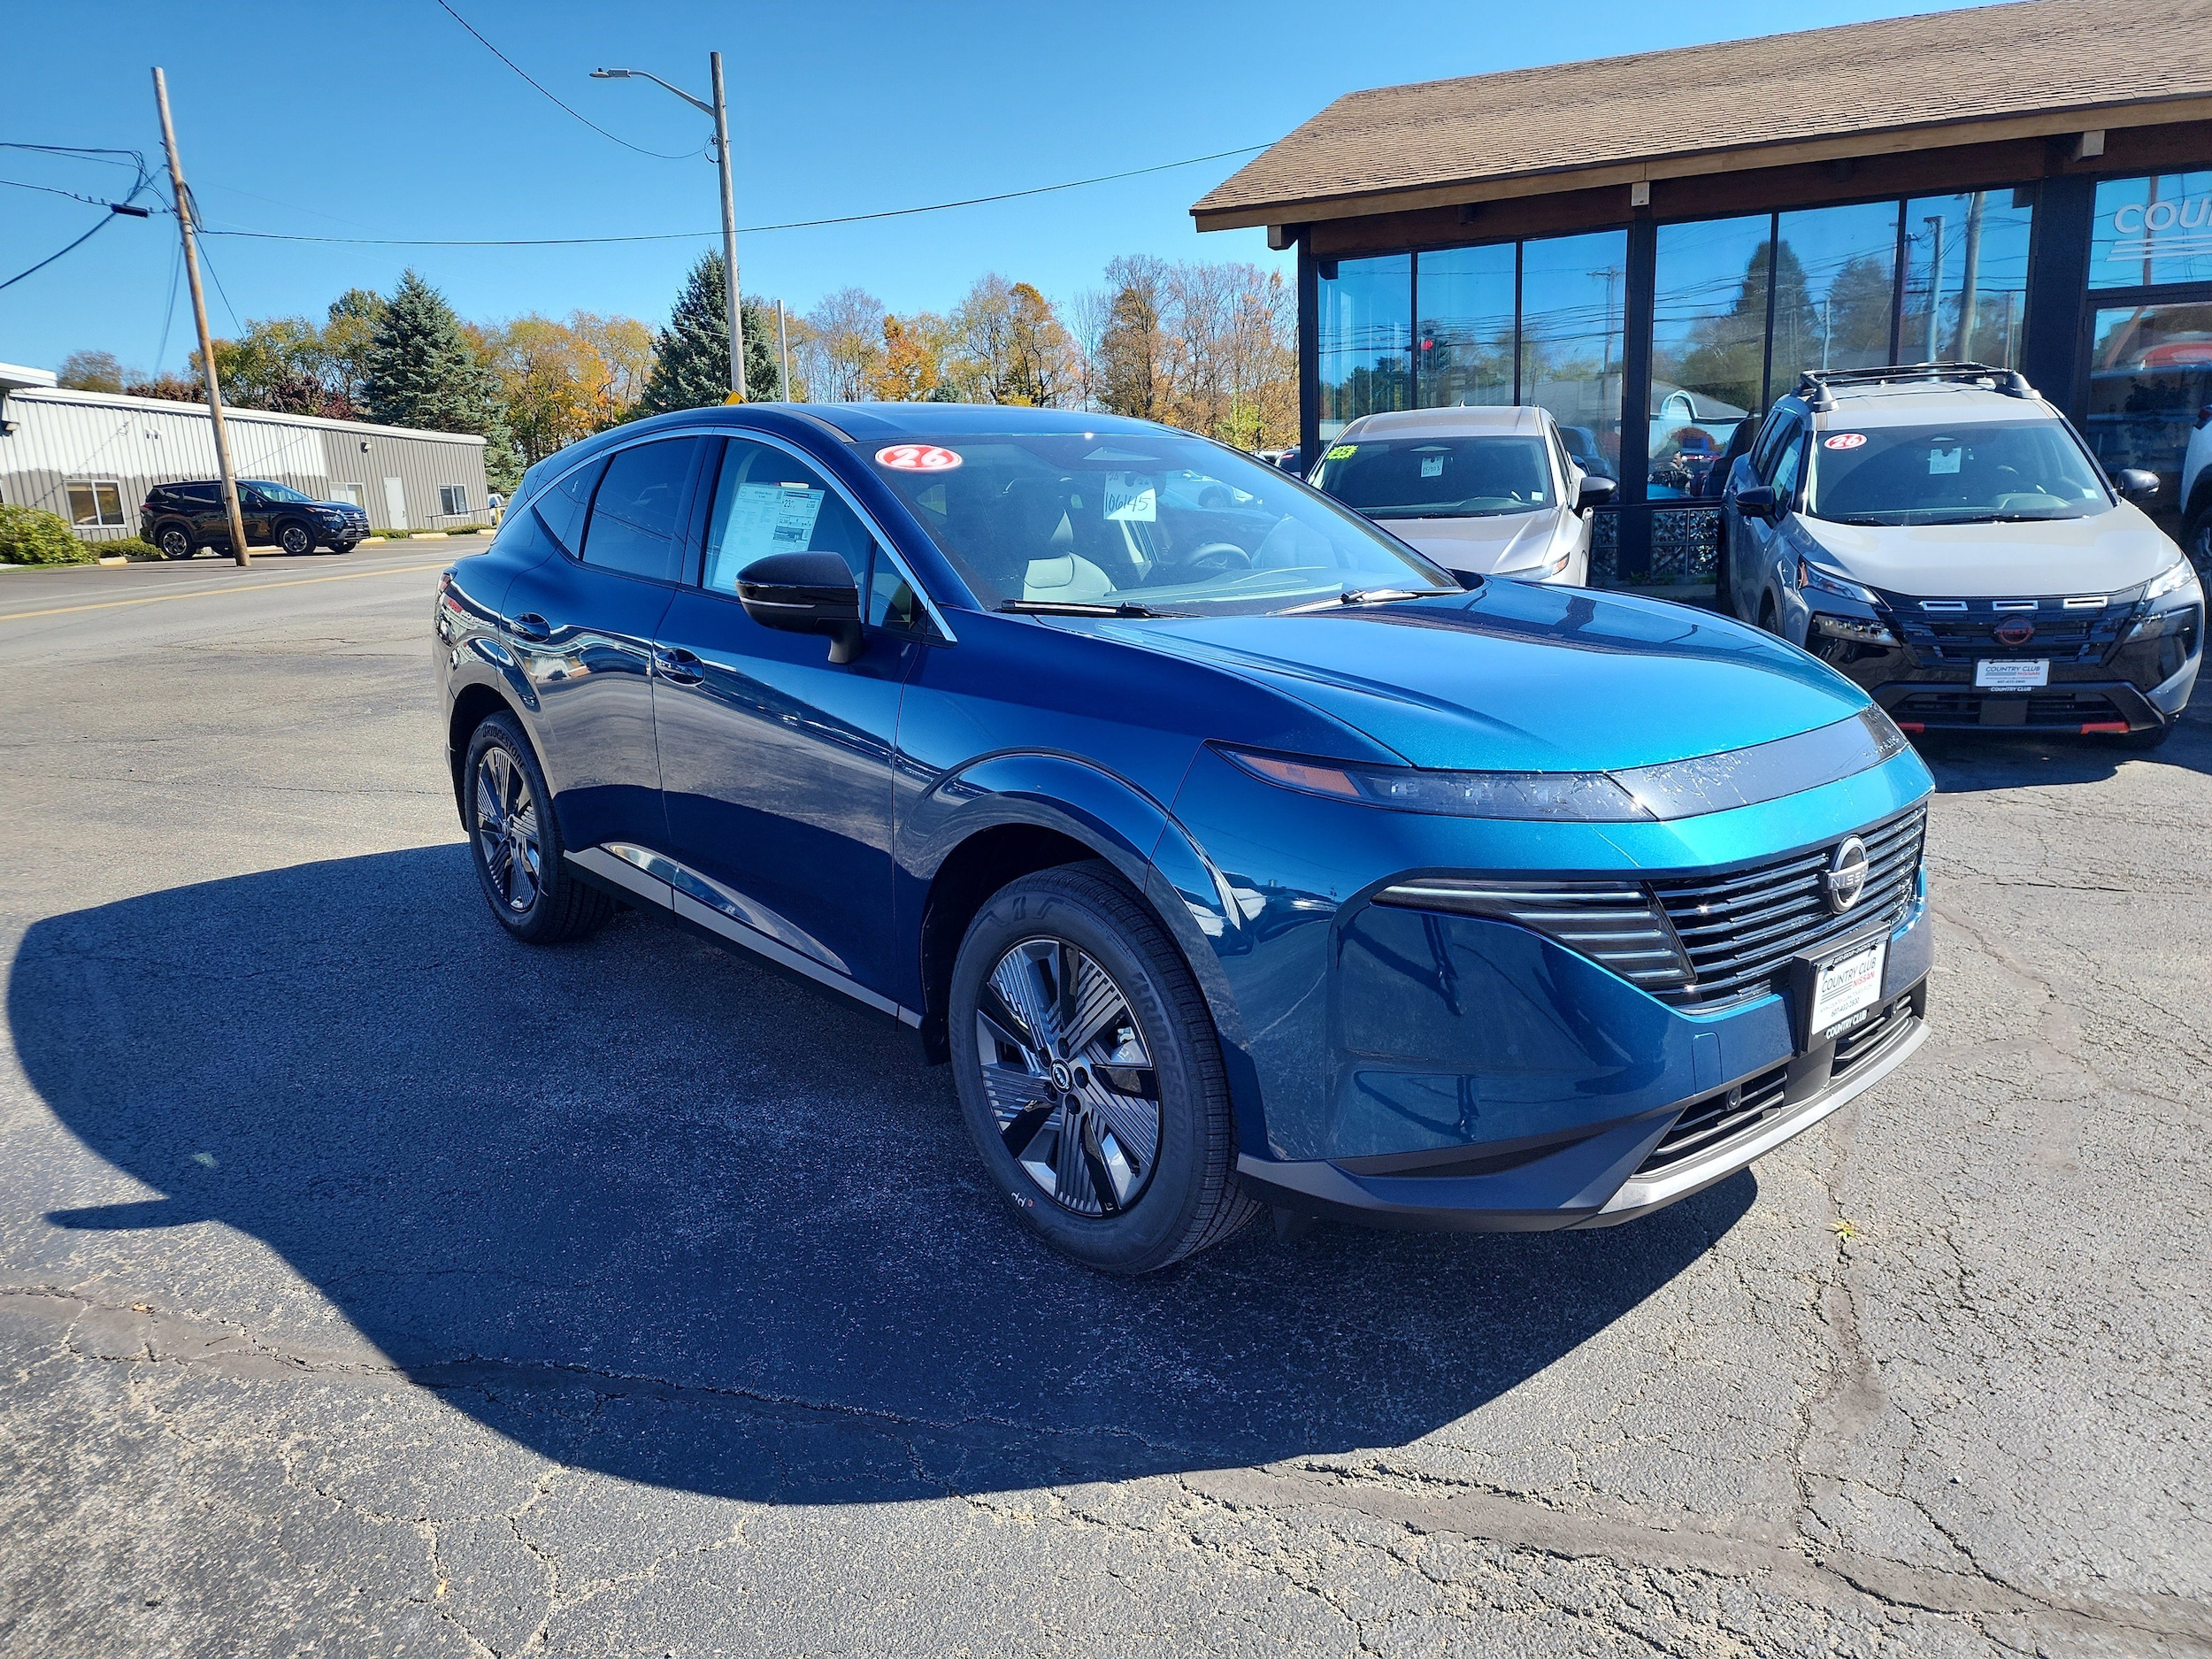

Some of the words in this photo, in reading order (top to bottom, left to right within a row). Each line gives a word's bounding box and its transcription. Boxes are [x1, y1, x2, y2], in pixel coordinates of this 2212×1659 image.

[2114, 197, 2212, 234] COU
[1832, 435, 1860, 448] 26
[892, 446, 949, 468] 26
[1105, 492, 1152, 512] 106145
[482, 723, 526, 771] BRIDGESTONE
[1821, 966, 1859, 993] COUNTRY
[1858, 957, 1877, 975] CLUB
[1853, 971, 1875, 988] NISSAN
[1825, 1017, 1853, 1040] COUNTRY
[1852, 1009, 1868, 1025] CLUB
